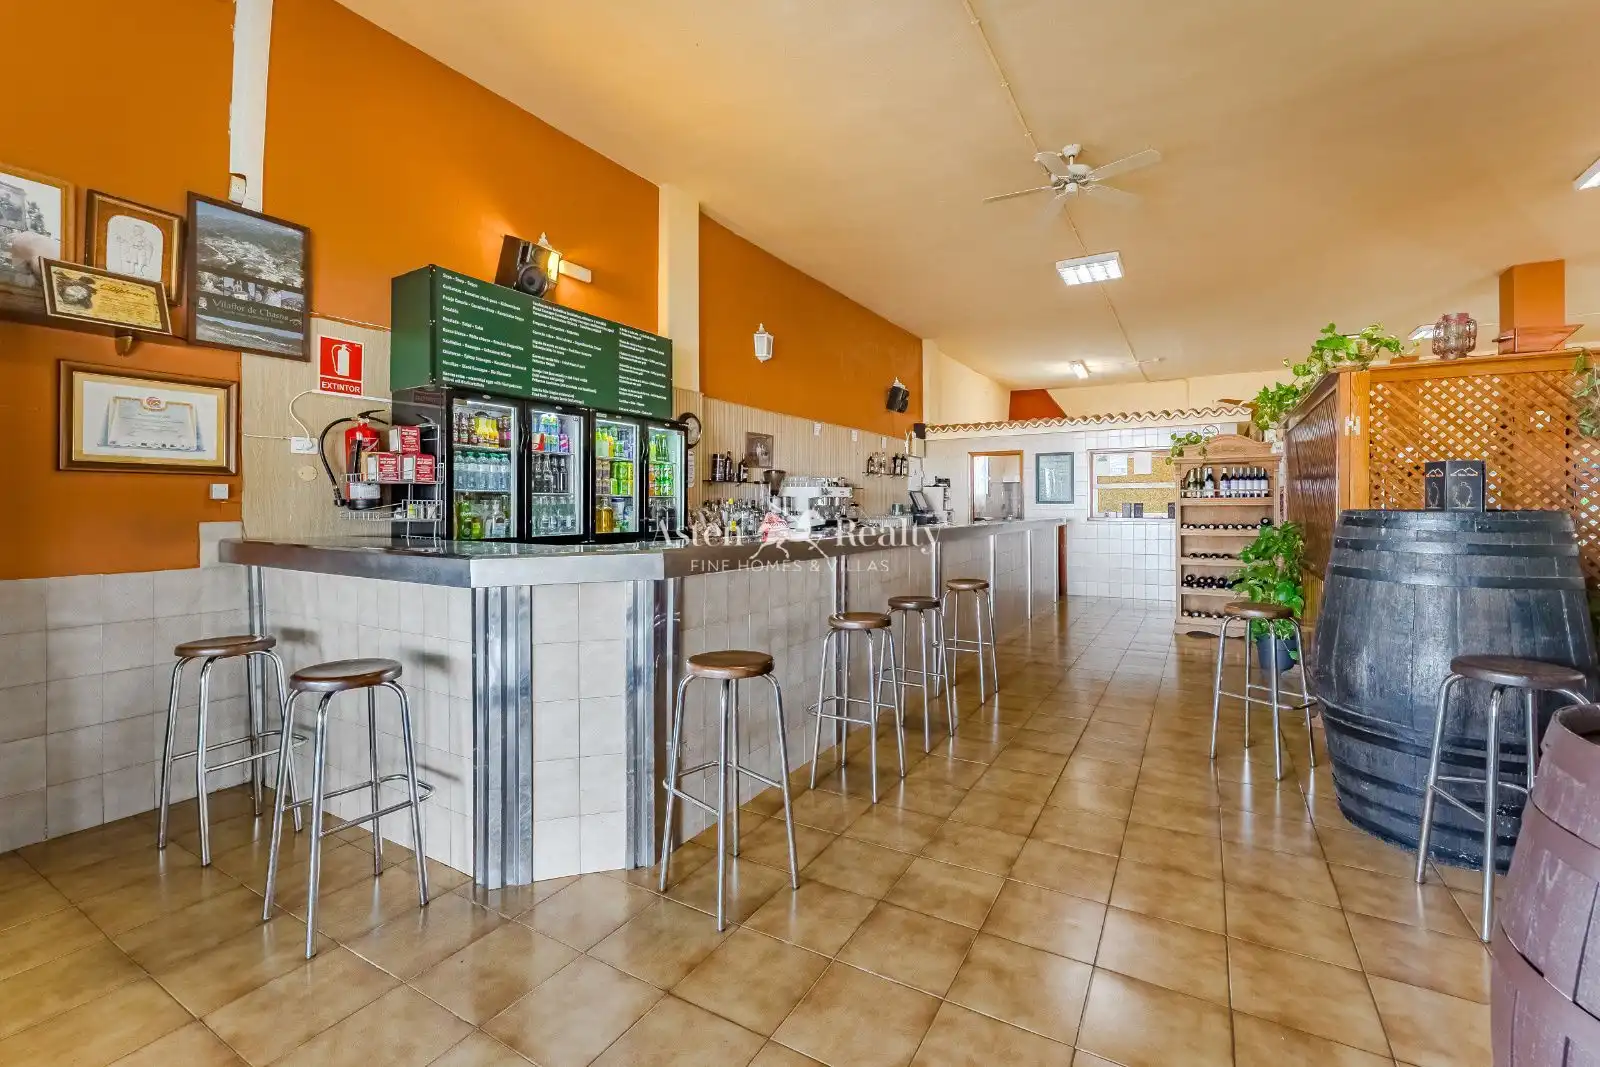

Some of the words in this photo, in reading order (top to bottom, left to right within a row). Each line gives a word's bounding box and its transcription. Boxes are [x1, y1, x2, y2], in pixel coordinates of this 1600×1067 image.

[212, 299, 246, 312] Vilaflor
[247, 306, 257, 315] de
[321, 381, 361, 393] EXTINTOR
